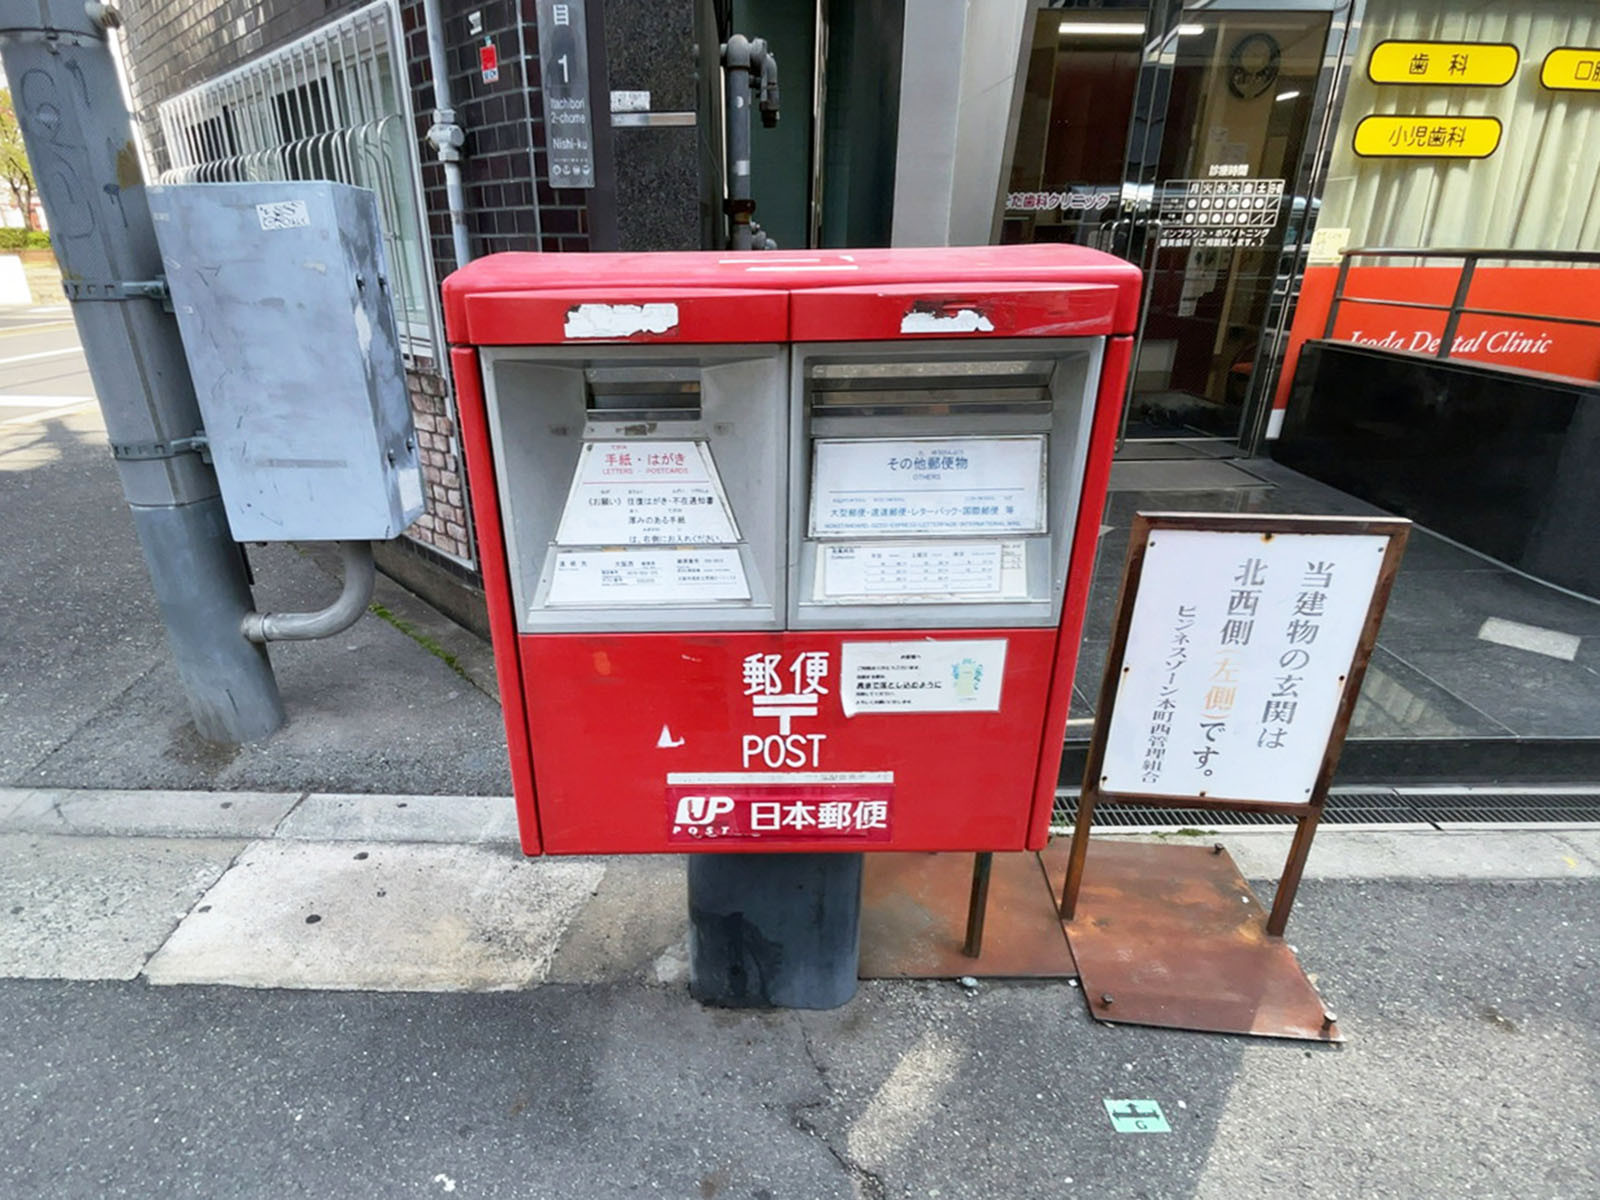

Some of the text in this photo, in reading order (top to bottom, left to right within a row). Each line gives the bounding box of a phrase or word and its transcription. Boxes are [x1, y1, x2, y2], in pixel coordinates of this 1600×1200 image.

[553, 4, 569, 26] 目
[558, 54, 569, 83] 1
[1408, 53, 1469, 76] 歯科
[553, 138, 588, 151] Nishi-ku
[1388, 126, 1466, 148] 小児歯科
[1190, 183, 1199, 194] 月
[1203, 183, 1213, 194] 火
[1216, 183, 1226, 194] 水
[1230, 183, 1240, 194] 木
[1243, 183, 1253, 194] 金
[1257, 183, 1266, 194] 土
[1408, 330, 1488, 353] Detal
[1486, 330, 1553, 354] Clinic
[604, 453, 685, 466] 手紙・はがき
[887, 456, 969, 471] その他郵便物
[1257, 560, 1335, 750] 当建物の玄関は
[742, 652, 829, 696] 郵便
[742, 734, 827, 768] POST
[750, 801, 888, 831] 日本郵便
